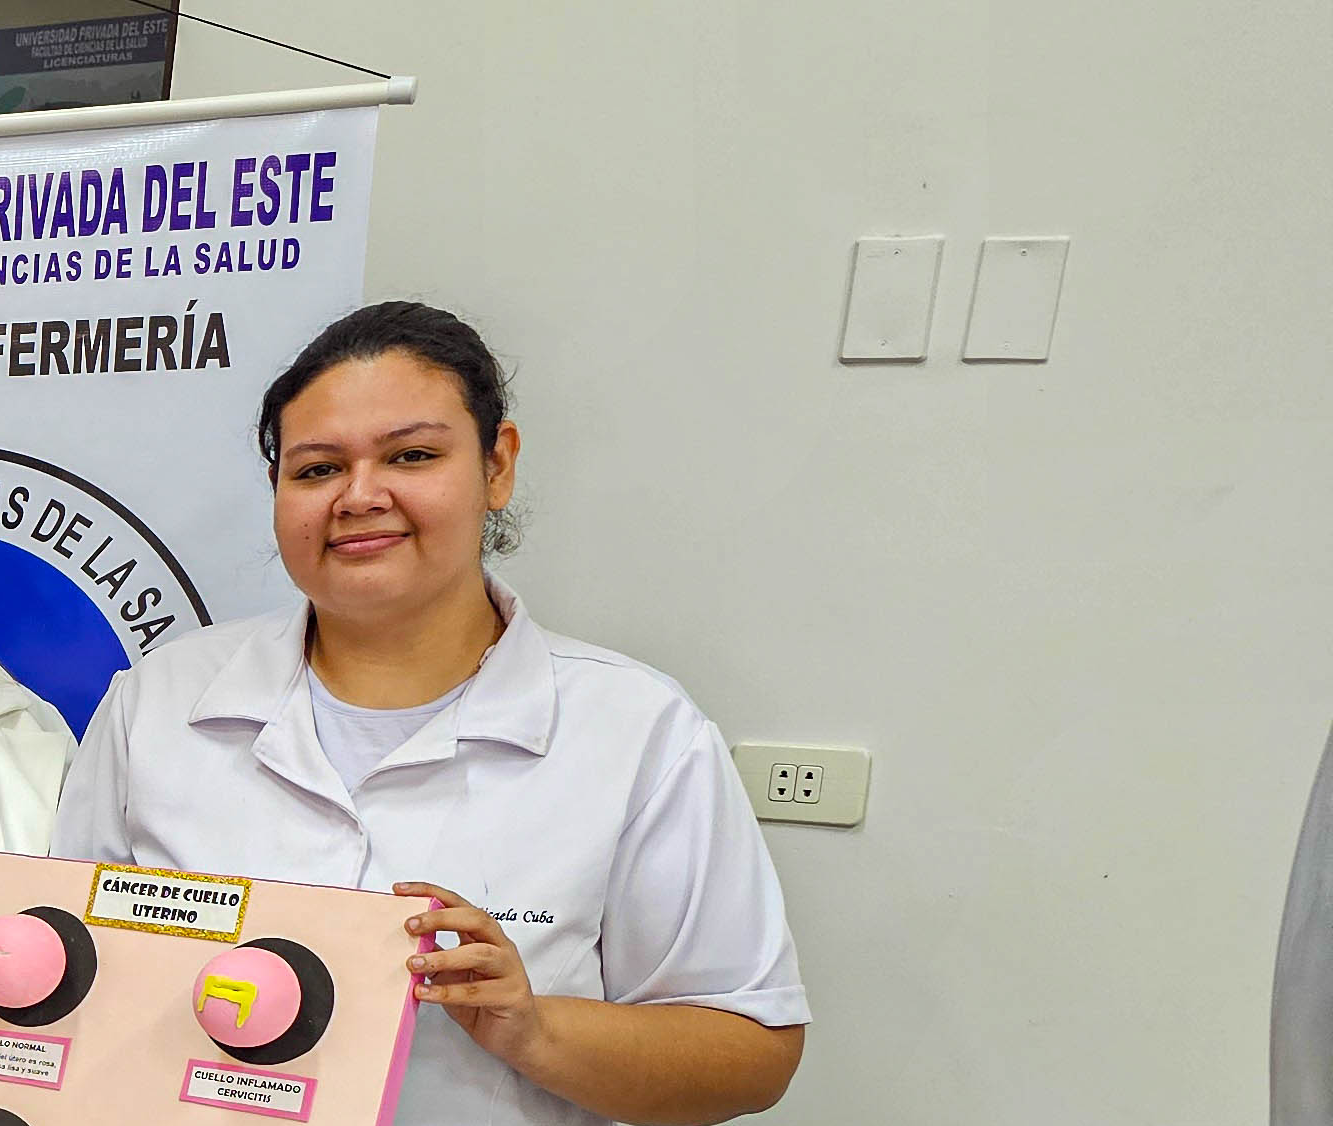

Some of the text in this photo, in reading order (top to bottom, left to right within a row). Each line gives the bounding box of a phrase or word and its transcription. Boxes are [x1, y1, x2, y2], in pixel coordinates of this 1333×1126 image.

[43, 52, 133, 69] LICENCIATURAS
[142, 161, 217, 233] DEL
[230, 151, 337, 228] ESTE
[94, 247, 133, 280] DE
[144, 244, 182, 278] LA
[193, 237, 301, 275] SALUD
[31, 498, 93, 560] DE
[80, 535, 138, 600] LA
[102, 876, 240, 907] CÁNCER DE CUELLO
[132, 903, 198, 924] UTERINO
[523, 910, 554, 924] Cuba
[12, 1041, 47, 1053] NORMAL
[194, 1070, 301, 1094] CUELLO INFLAMADO
[217, 1087, 272, 1103] CERVICITIS
